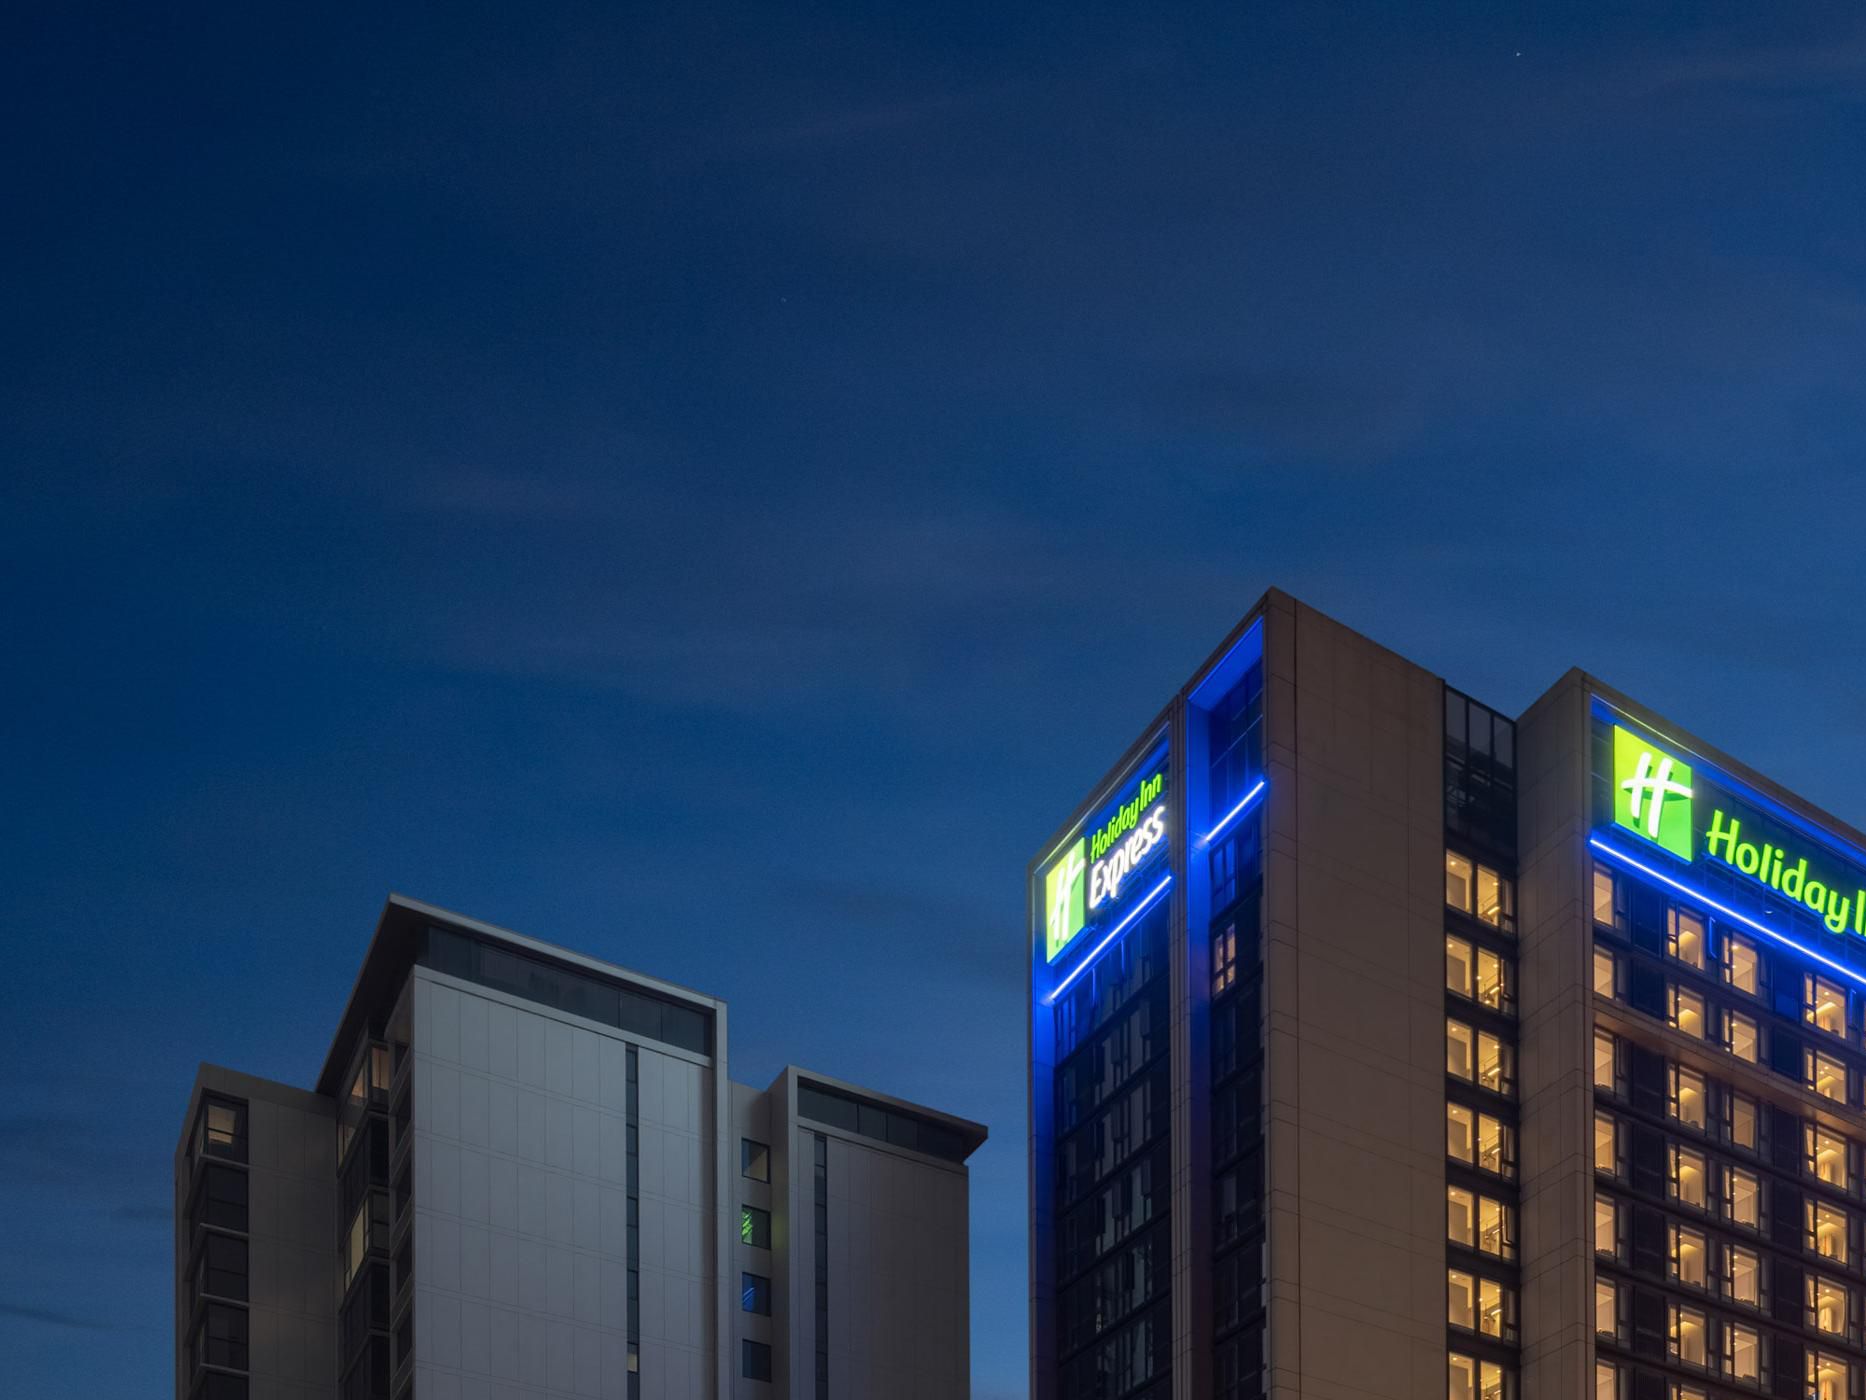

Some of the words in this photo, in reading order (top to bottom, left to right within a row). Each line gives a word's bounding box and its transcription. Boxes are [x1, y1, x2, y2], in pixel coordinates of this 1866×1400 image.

[1088, 805, 1166, 909] Express
[1090, 798, 1140, 864] Holiday
[1139, 774, 1162, 812] Inn
[1706, 810, 1849, 933] Holiday
